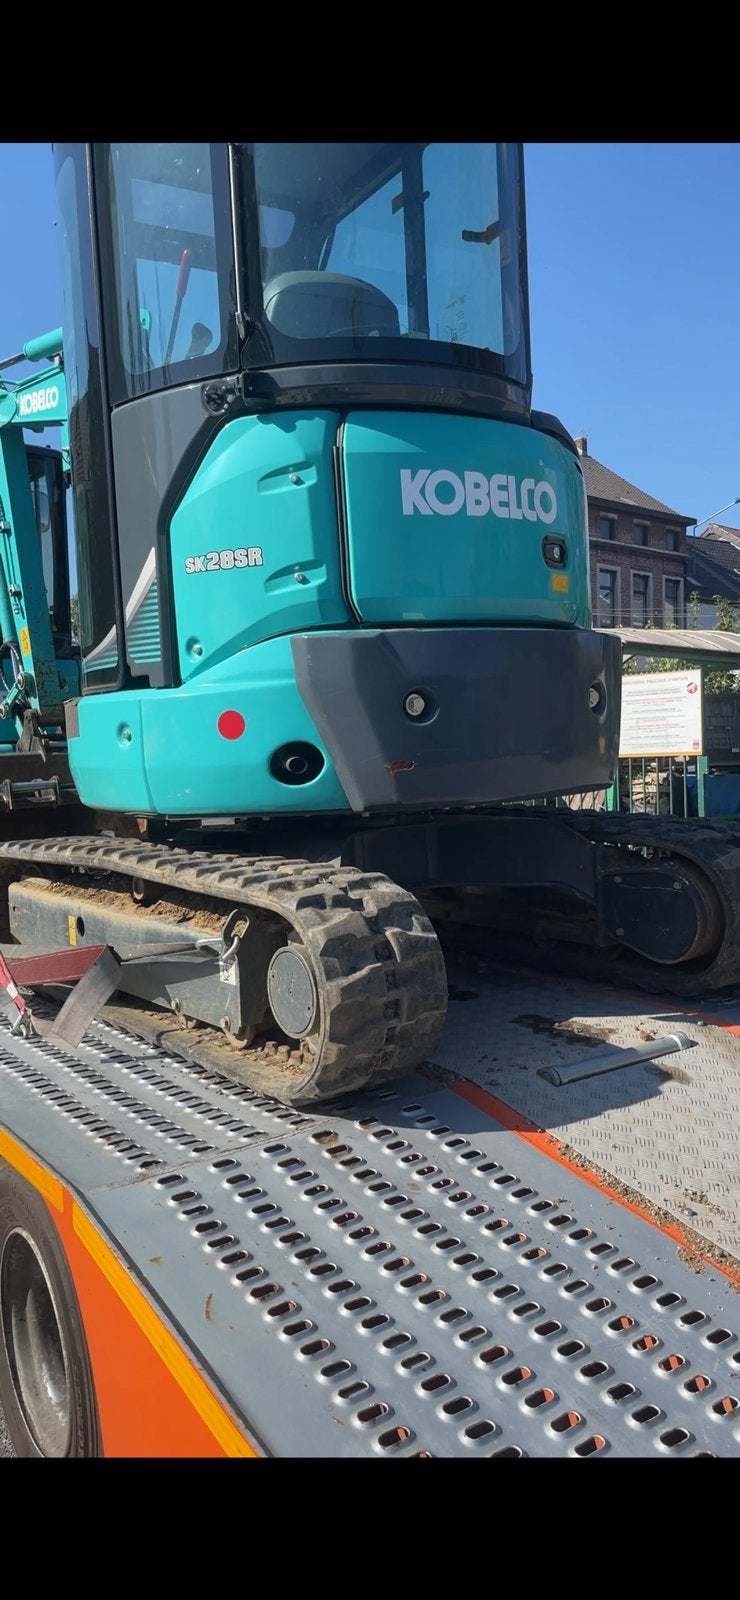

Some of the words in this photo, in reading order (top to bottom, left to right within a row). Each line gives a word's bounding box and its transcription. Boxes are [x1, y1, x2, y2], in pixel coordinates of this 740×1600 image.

[19, 385, 59, 416] KOBELCO
[399, 468, 558, 525] KOBELCO
[184, 546, 263, 575] SK28SR
